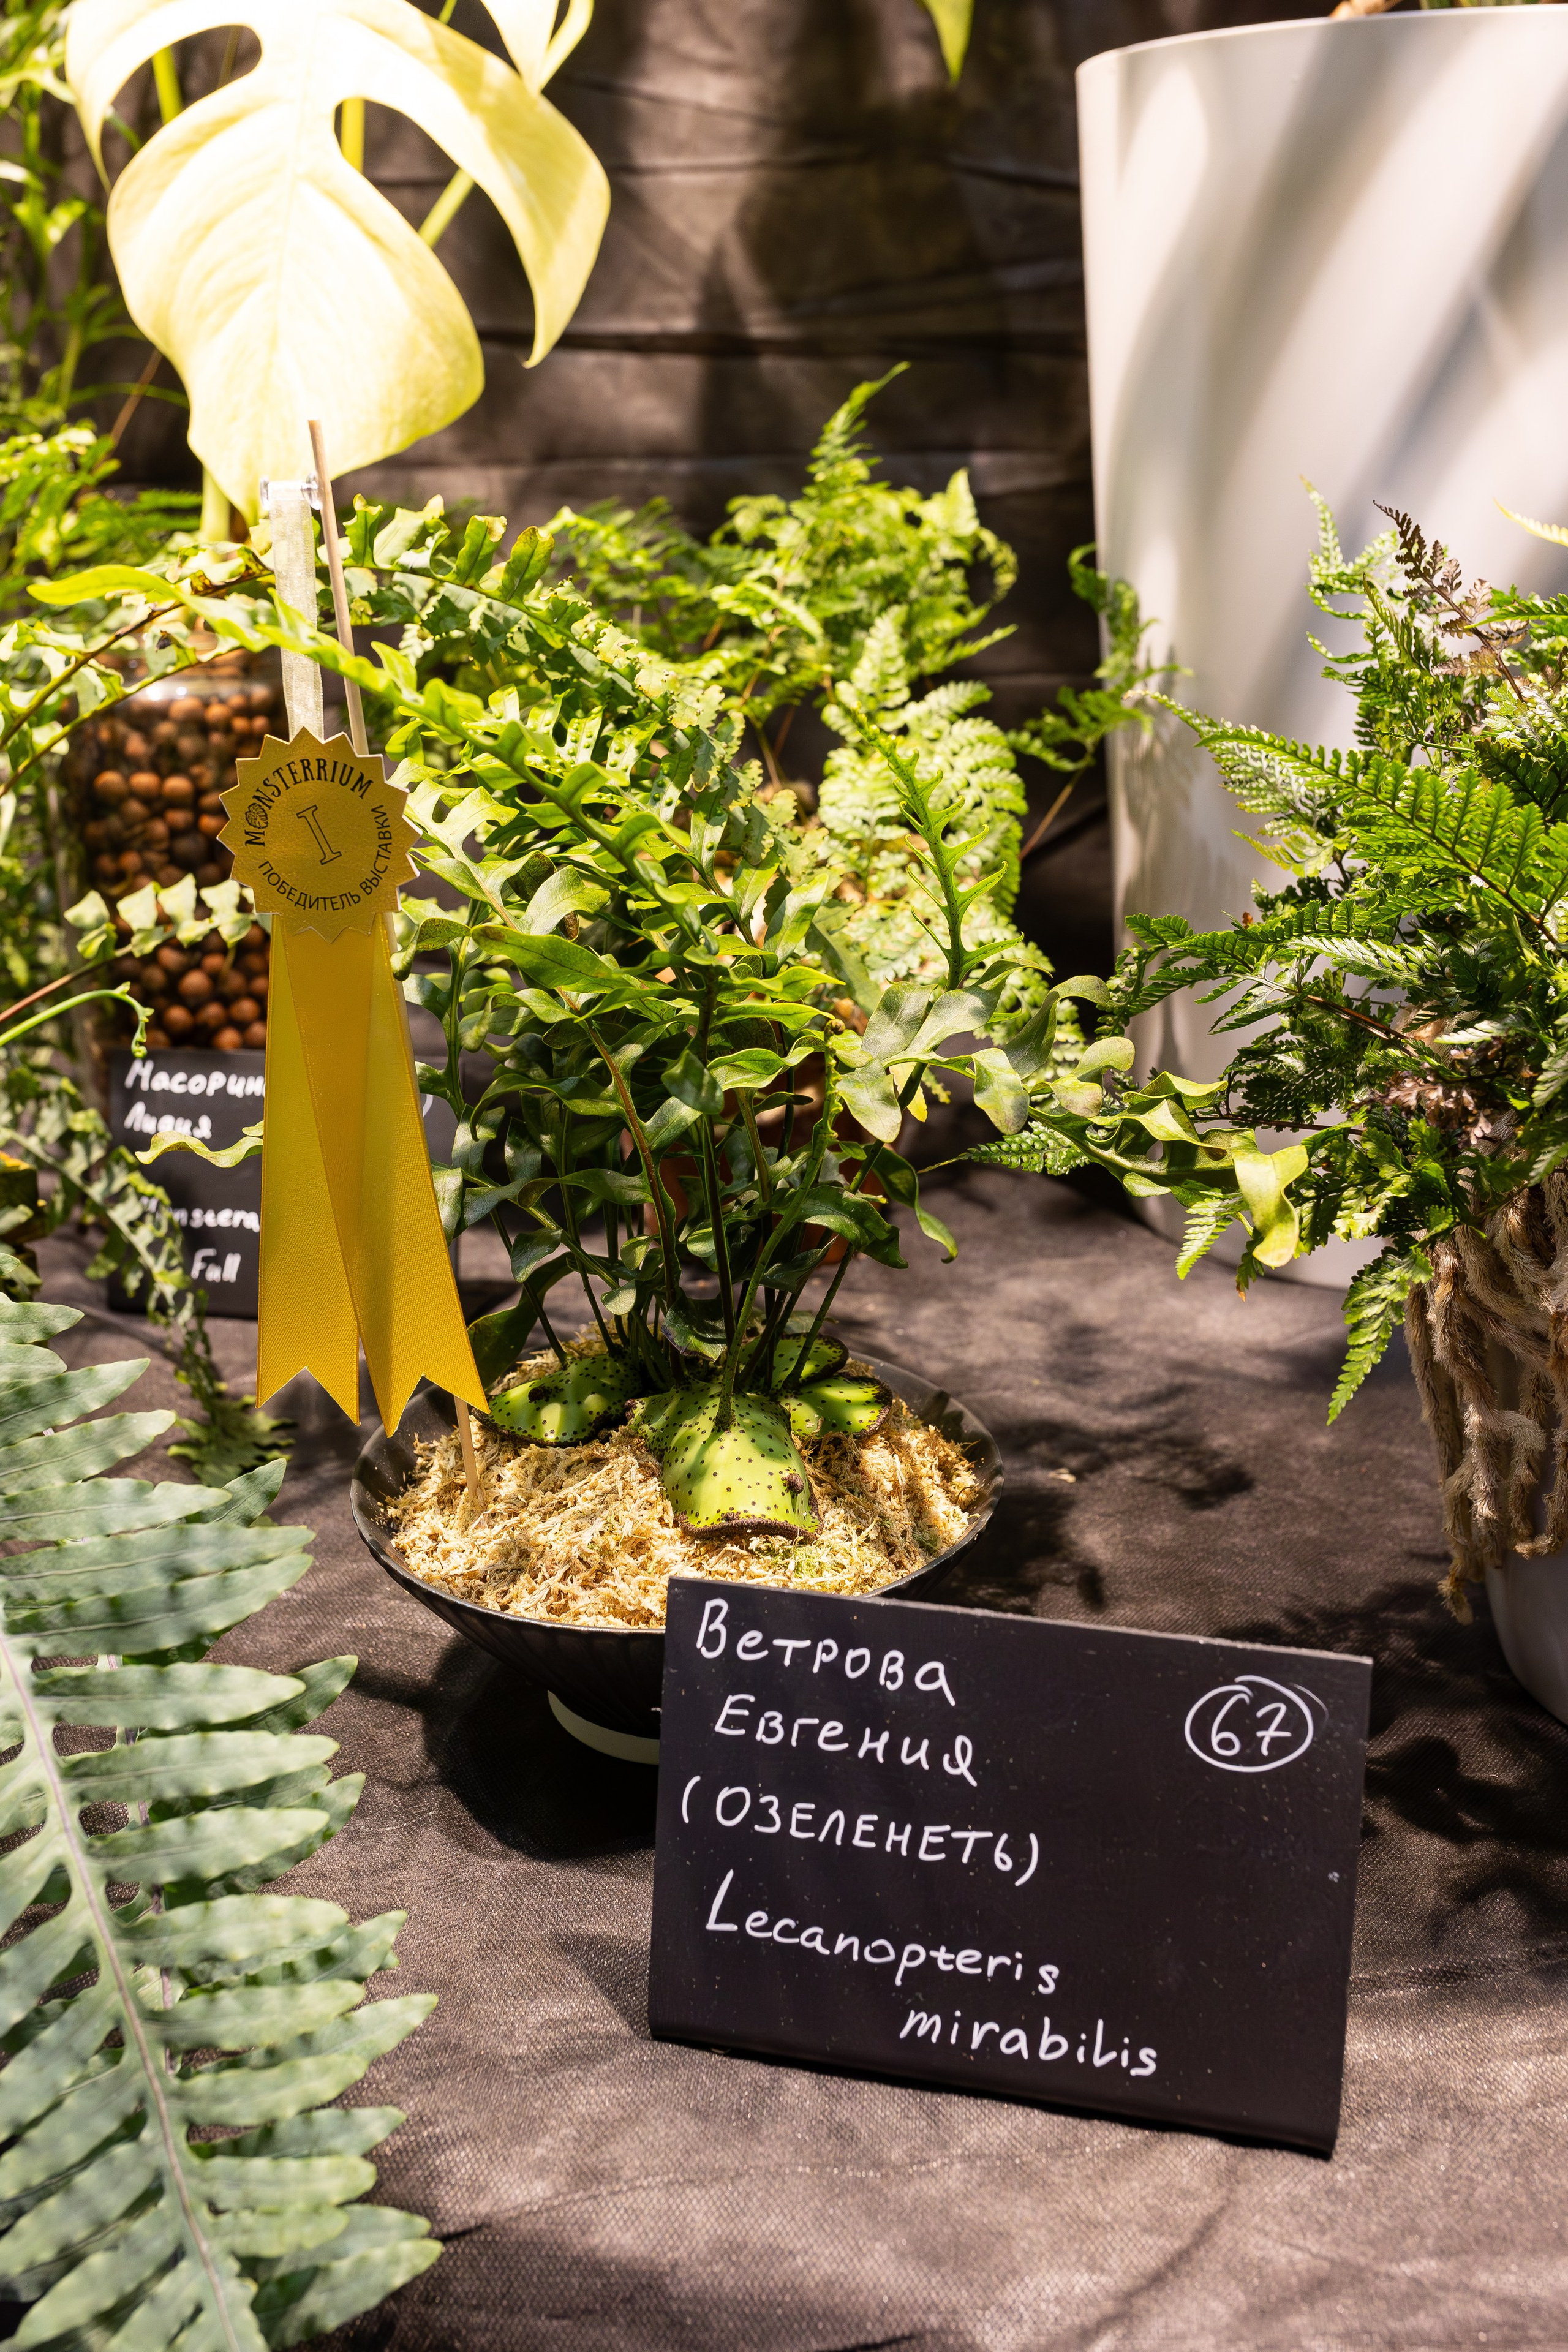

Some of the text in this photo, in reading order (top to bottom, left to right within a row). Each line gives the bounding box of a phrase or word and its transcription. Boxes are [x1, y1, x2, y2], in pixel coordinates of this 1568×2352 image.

[258, 804, 393, 911] ПОБЕДИТЕЛЬ ВЫСТАВКИ
[124, 1058, 266, 1098] Масорин
[695, 1597, 957, 1708] Ветрова
[714, 1693, 978, 1787] Евгения
[1210, 1692, 1292, 1757] 67
[705, 1868, 1060, 1995] Lecanopteris
[899, 2009, 1158, 2077] mirabilis
